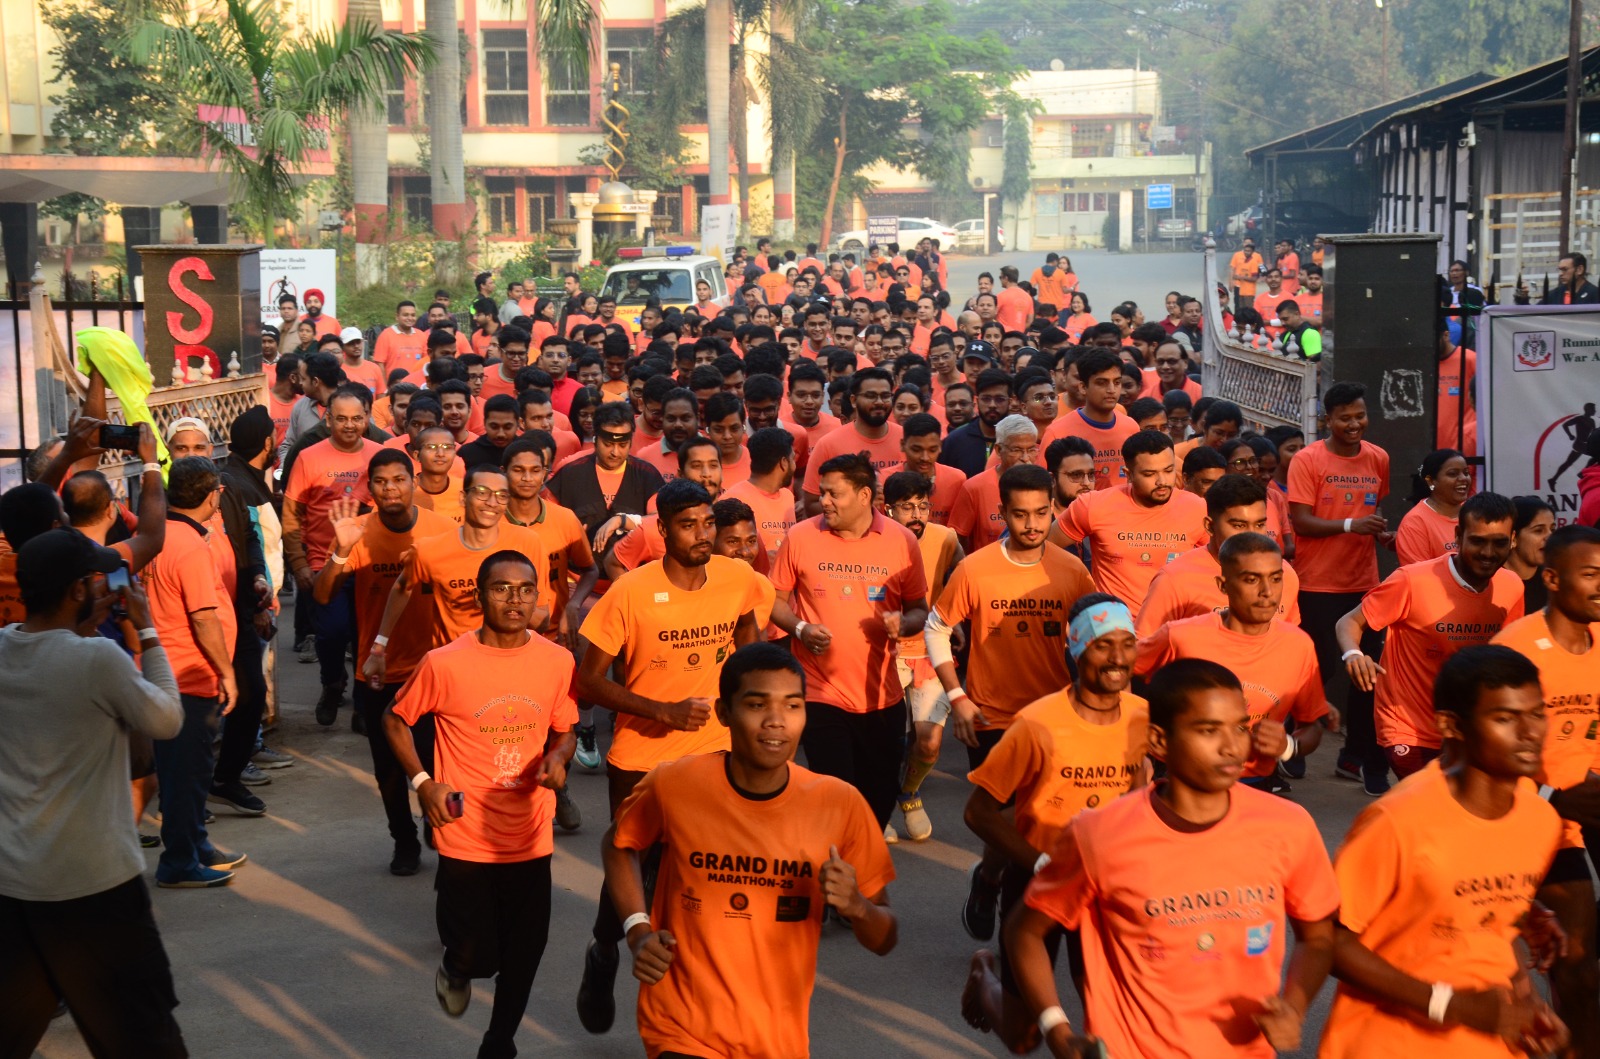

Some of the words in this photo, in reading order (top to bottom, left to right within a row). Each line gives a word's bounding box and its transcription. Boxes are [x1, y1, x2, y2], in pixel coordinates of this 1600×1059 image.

[878, 217, 896, 225] WHEELER
[869, 226, 896, 235] PARKING
[1562, 353, 1588, 362] War
[1326, 475, 1359, 484] GRAND
[1361, 476, 1377, 484] IMA
[761, 521, 787, 530] GRAND
[1117, 532, 1162, 542] GRAND
[1165, 532, 1187, 542] IMA
[818, 562, 862, 574] GRAND
[866, 565, 889, 576] IMA
[991, 599, 1037, 610] GRAND
[1040, 599, 1063, 610] IMA
[658, 626, 710, 642] GRAND
[713, 620, 736, 636] IMA
[1435, 622, 1482, 634] GRAND
[672, 635, 727, 650] MARATHON-25
[474, 697, 506, 719] Running
[522, 696, 542, 715] Health
[479, 725, 499, 733] War
[502, 722, 536, 735] Against
[492, 736, 525, 745] Cancer
[1060, 765, 1117, 779] GRAND
[689, 851, 768, 874] GRAND
[773, 858, 813, 878] IMA
[707, 872, 794, 889] MARATHON-25
[1144, 889, 1230, 918] GRAND
[1237, 885, 1276, 904] IMA
